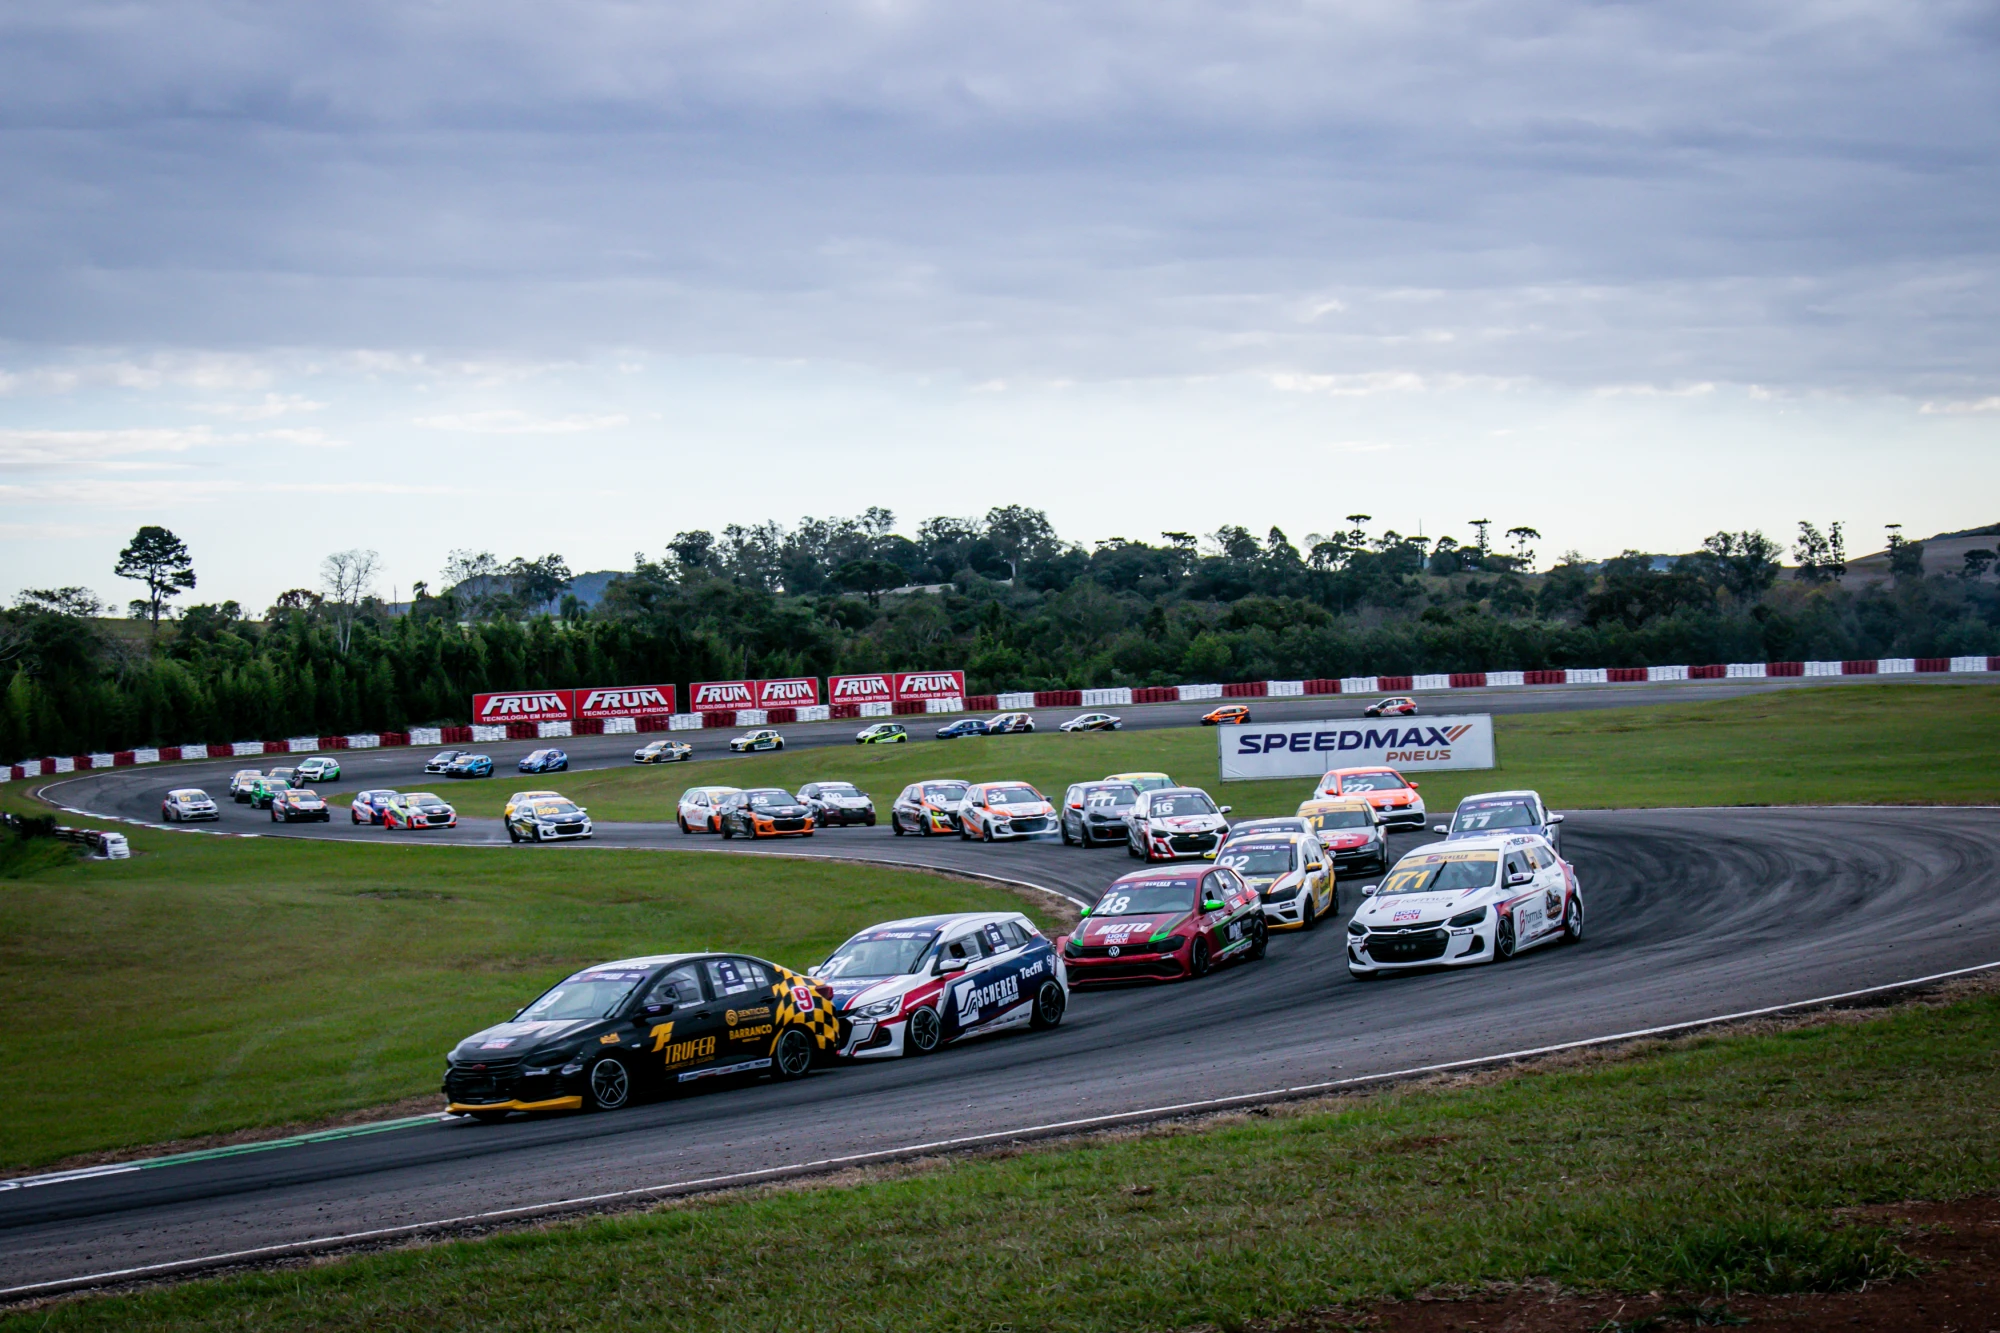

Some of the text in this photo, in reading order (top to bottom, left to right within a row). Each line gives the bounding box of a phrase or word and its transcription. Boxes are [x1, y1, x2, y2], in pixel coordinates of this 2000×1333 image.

[761, 681, 814, 700] FRUM
[834, 677, 890, 696] FRUM
[900, 674, 960, 693] FRUM
[582, 688, 668, 710] FRUM
[696, 684, 752, 703] FRUM
[481, 693, 566, 715] FRUM
[583, 709, 629, 717] TECNOLOGIA
[482, 714, 528, 722] TECNOLOGIA
[1238, 725, 1453, 754] SPEEDMAX
[1385, 749, 1451, 763] PNEUS
[751, 796, 768, 804] 45
[924, 793, 946, 803] 118
[988, 793, 1007, 803] 34
[1087, 796, 1118, 807] 777
[1153, 802, 1174, 813] 16
[1462, 815, 1490, 829] 77
[1220, 855, 1250, 871] 92
[1386, 870, 1430, 892] 171
[1095, 896, 1130, 915] 48
[1095, 922, 1153, 936] MOTO
[726, 971, 735, 980] 9
[817, 955, 854, 977] 51
[1020, 960, 1043, 979] Tecfil
[792, 986, 815, 1012] 9
[976, 975, 1018, 1008] SCHERER
[534, 991, 565, 1012] 9
[729, 1024, 772, 1040] BARRANCO
[665, 1036, 716, 1064] TRUFER
